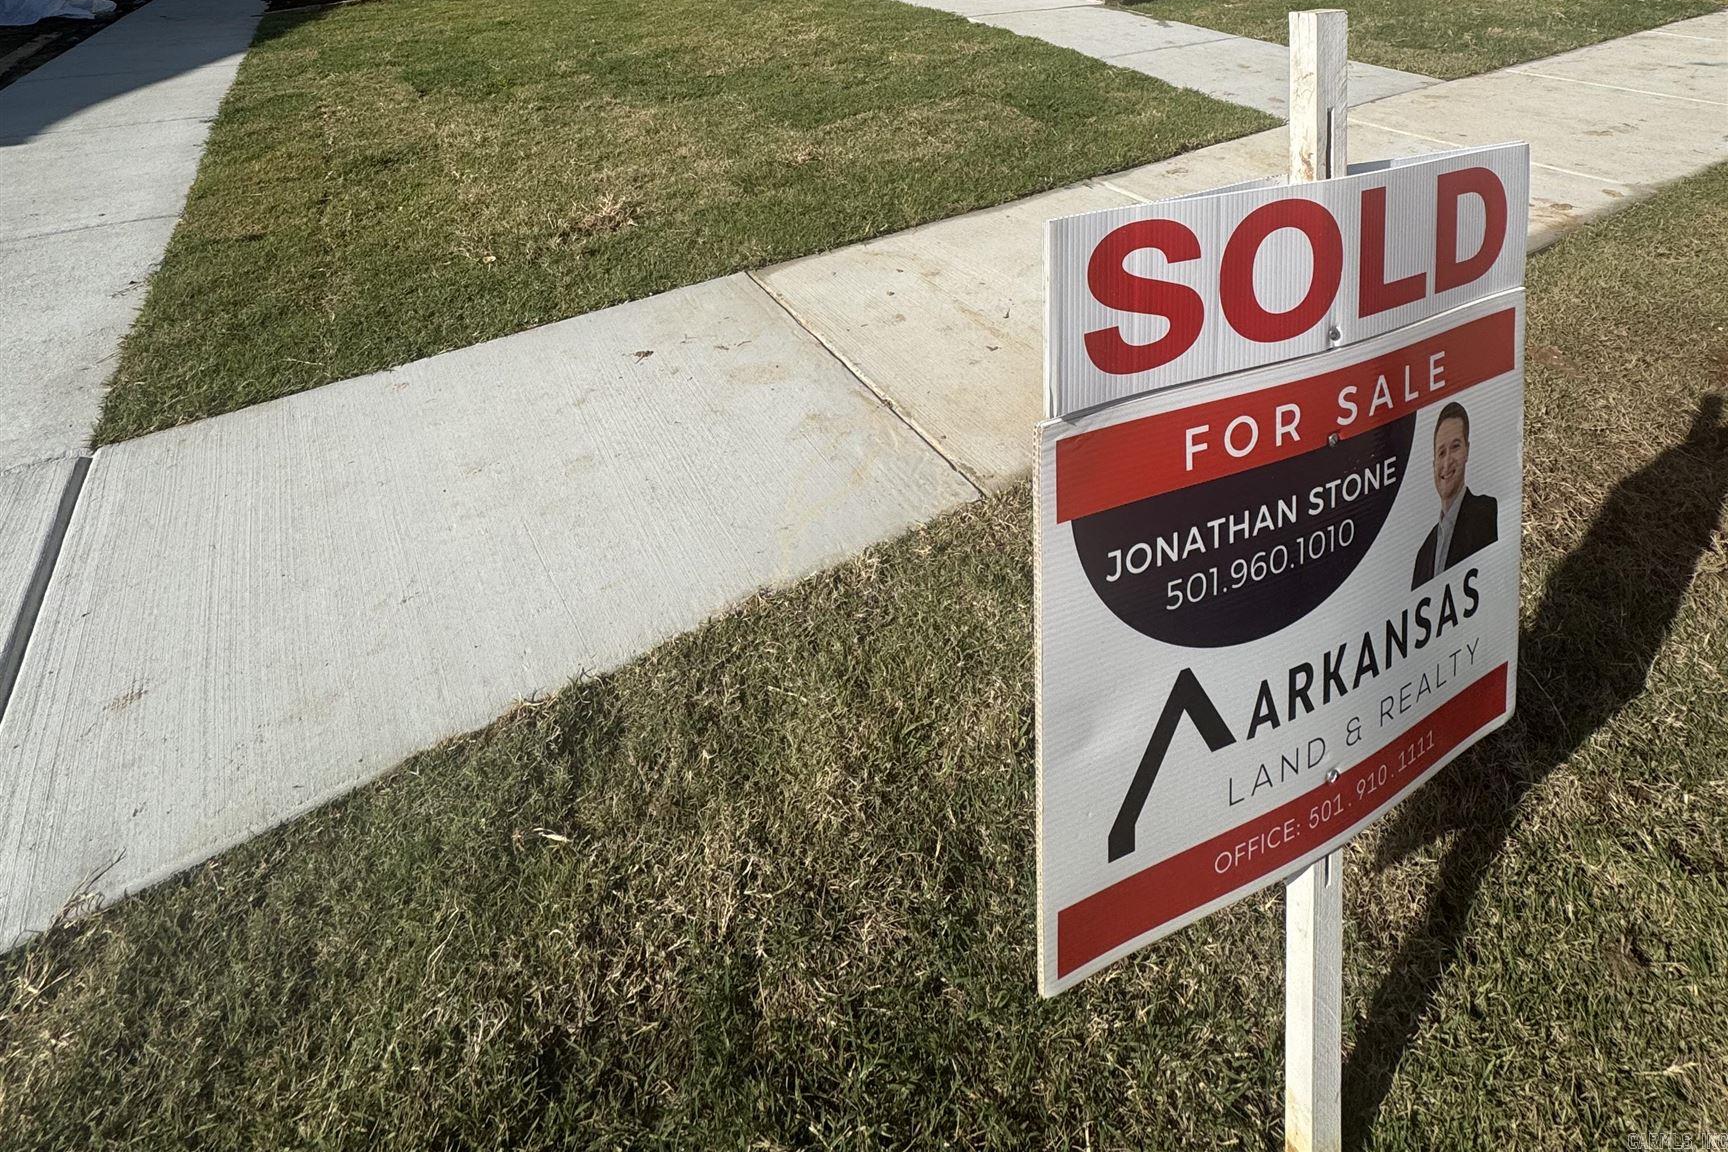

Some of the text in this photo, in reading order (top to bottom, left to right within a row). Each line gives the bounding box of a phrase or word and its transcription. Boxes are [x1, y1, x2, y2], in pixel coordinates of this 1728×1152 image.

[1084, 166, 1508, 375] SOLD
[1184, 351, 1447, 472] FOR SALE
[1105, 456, 1397, 582] JONATHAN STONE
[1166, 519, 1355, 611] 501.960.1010
[1246, 568, 1480, 740] ARKANSAS
[1228, 637, 1479, 807] LAND & REALTY
[1214, 817, 1301, 874] OFFICE:
